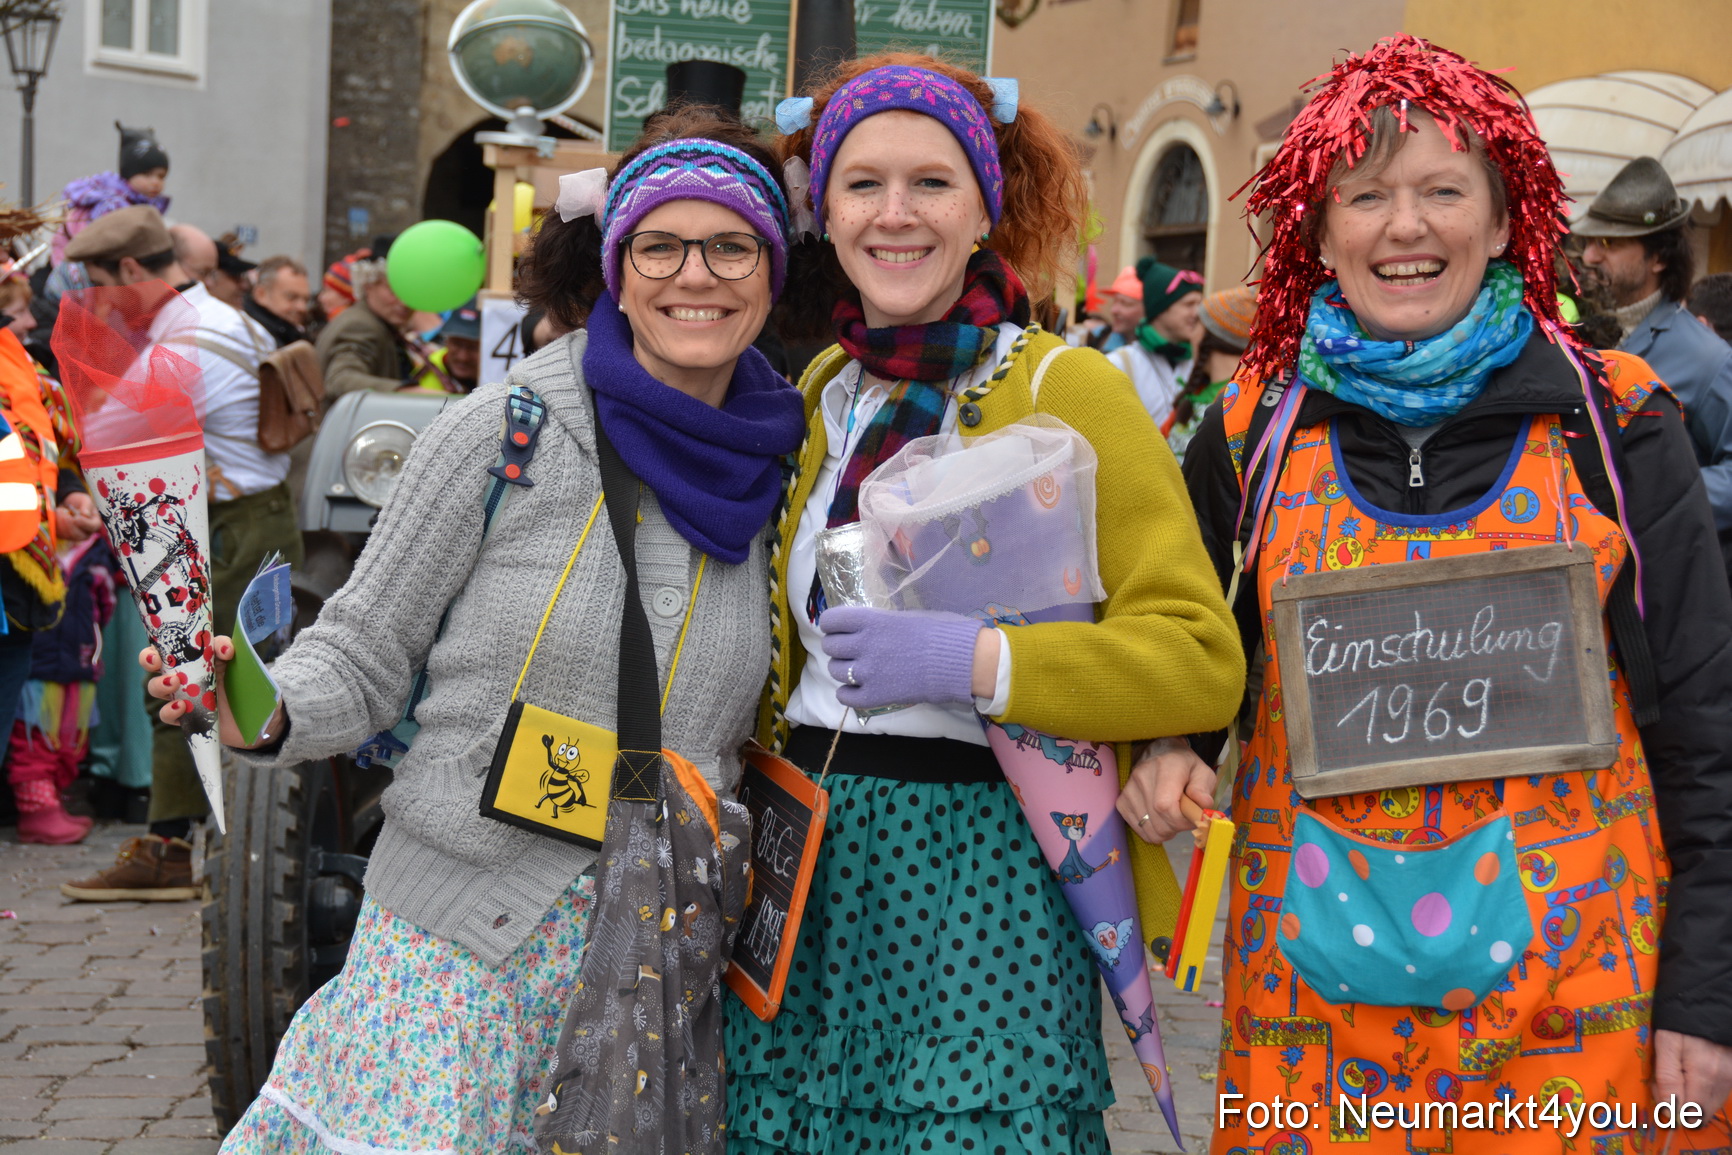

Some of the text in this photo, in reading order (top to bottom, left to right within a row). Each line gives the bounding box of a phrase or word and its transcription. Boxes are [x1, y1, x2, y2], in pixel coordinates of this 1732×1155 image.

[491, 322, 518, 371] 4
[1305, 604, 1563, 683] Einschulung
[1336, 677, 1491, 744] 1969
